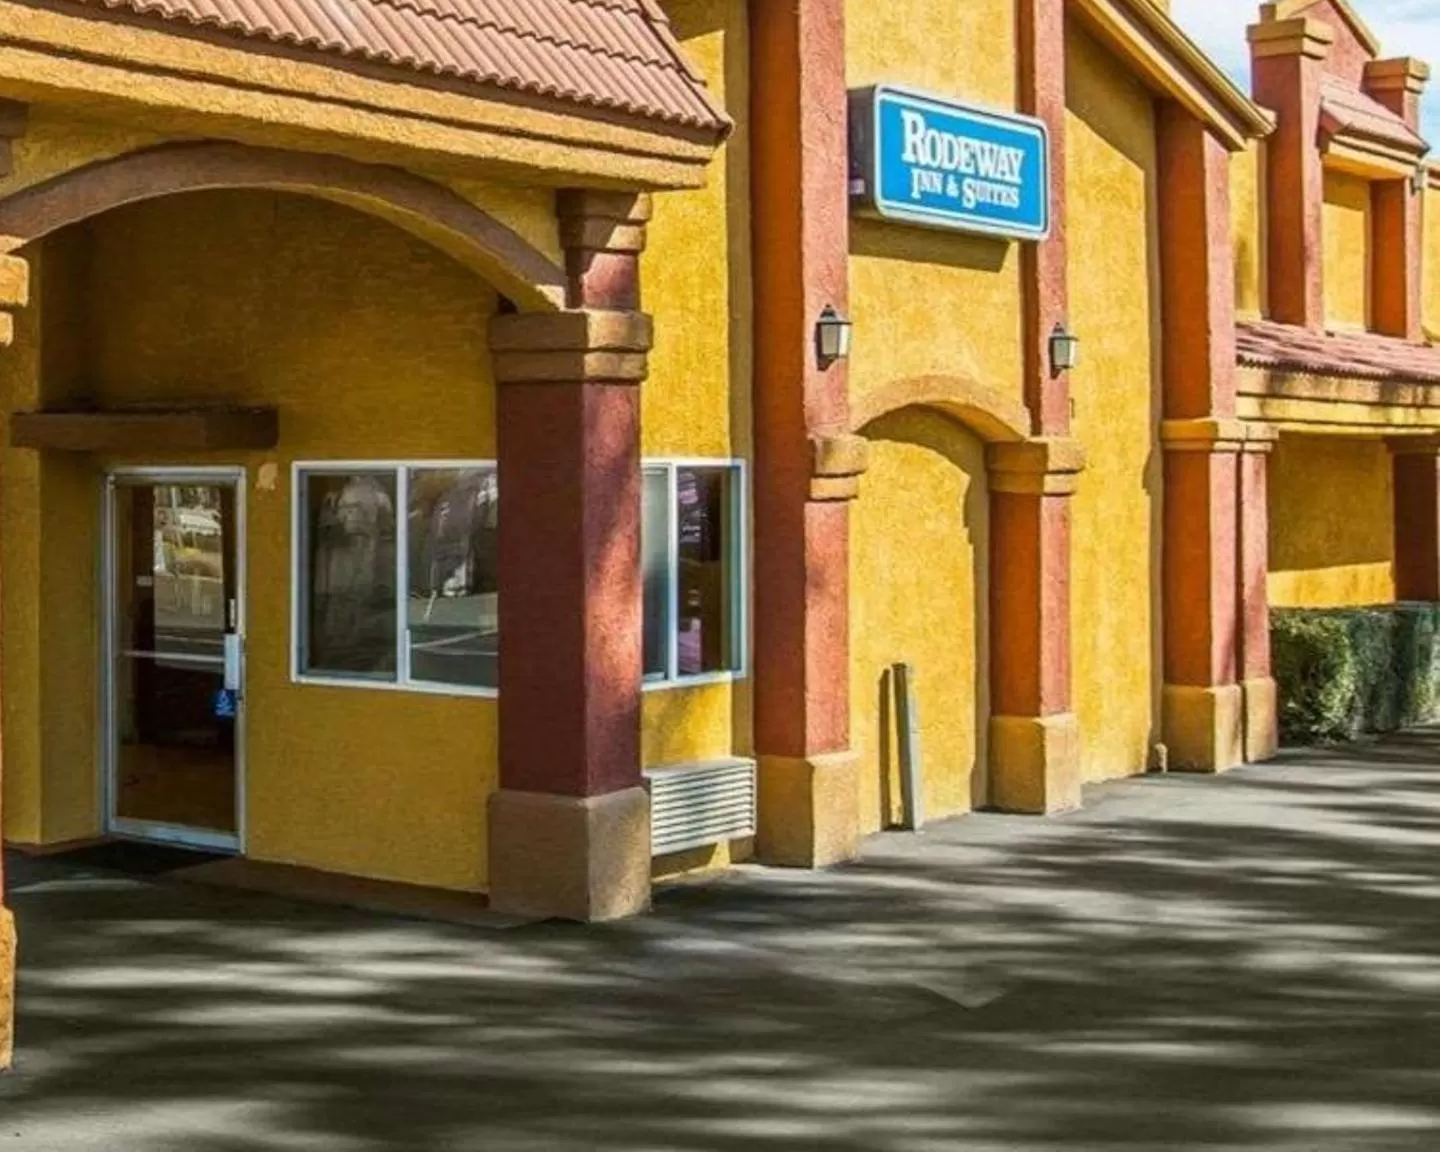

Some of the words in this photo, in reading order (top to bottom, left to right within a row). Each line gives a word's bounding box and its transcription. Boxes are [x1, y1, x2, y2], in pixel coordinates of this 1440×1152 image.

[900, 109, 1025, 185] RODEWAY
[911, 168, 944, 199] INN
[946, 174, 960, 198] &
[962, 177, 1020, 209] SUITES
